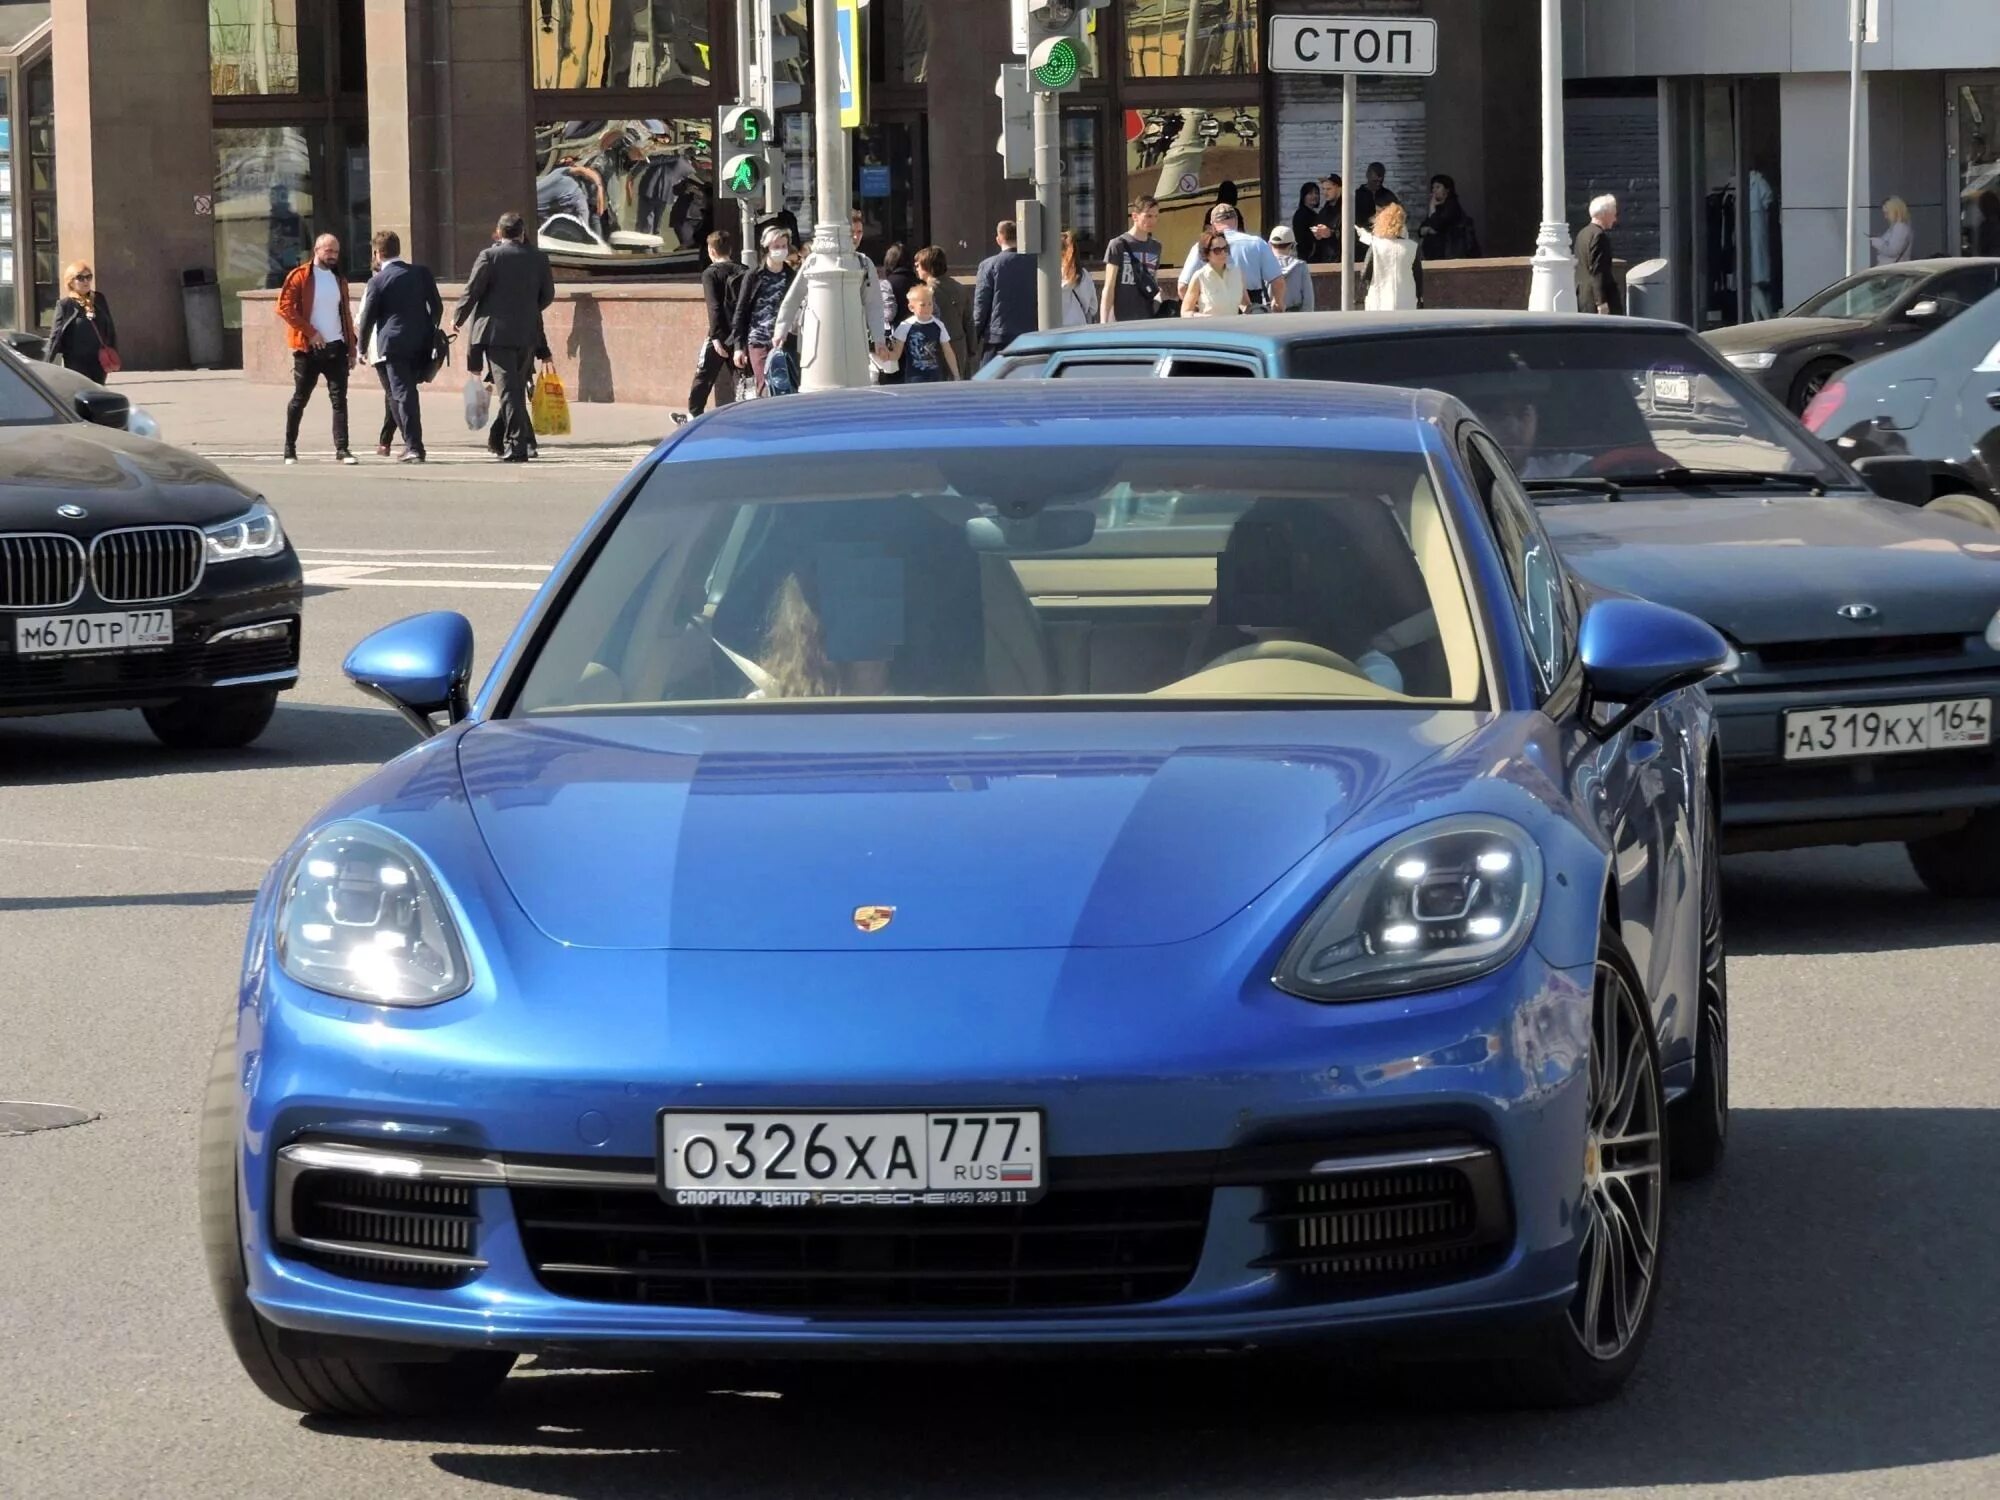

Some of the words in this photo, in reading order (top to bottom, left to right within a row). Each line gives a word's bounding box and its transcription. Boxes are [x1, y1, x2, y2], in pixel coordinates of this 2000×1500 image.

[1294, 27, 1412, 64] СТОП
[743, 117, 757, 141] 5
[25, 618, 123, 649] М670ТР
[129, 611, 165, 635] 777
[1796, 712, 1925, 753] А319КХ
[1934, 701, 1986, 732] 164
[1943, 730, 1967, 742] RUS
[683, 1122, 918, 1180] О326ХА
[932, 1117, 1021, 1162] 777
[954, 1164, 998, 1181] RUS
[676, 1190, 811, 1207] СПОРТКАР-ЦЕНТР
[821, 1193, 945, 1205] PORSCHE
[945, 1191, 975, 1205] (495)
[976, 1191, 998, 1203] 249
[1000, 1191, 1012, 1203] 11
[1016, 1191, 1027, 1203] 11
